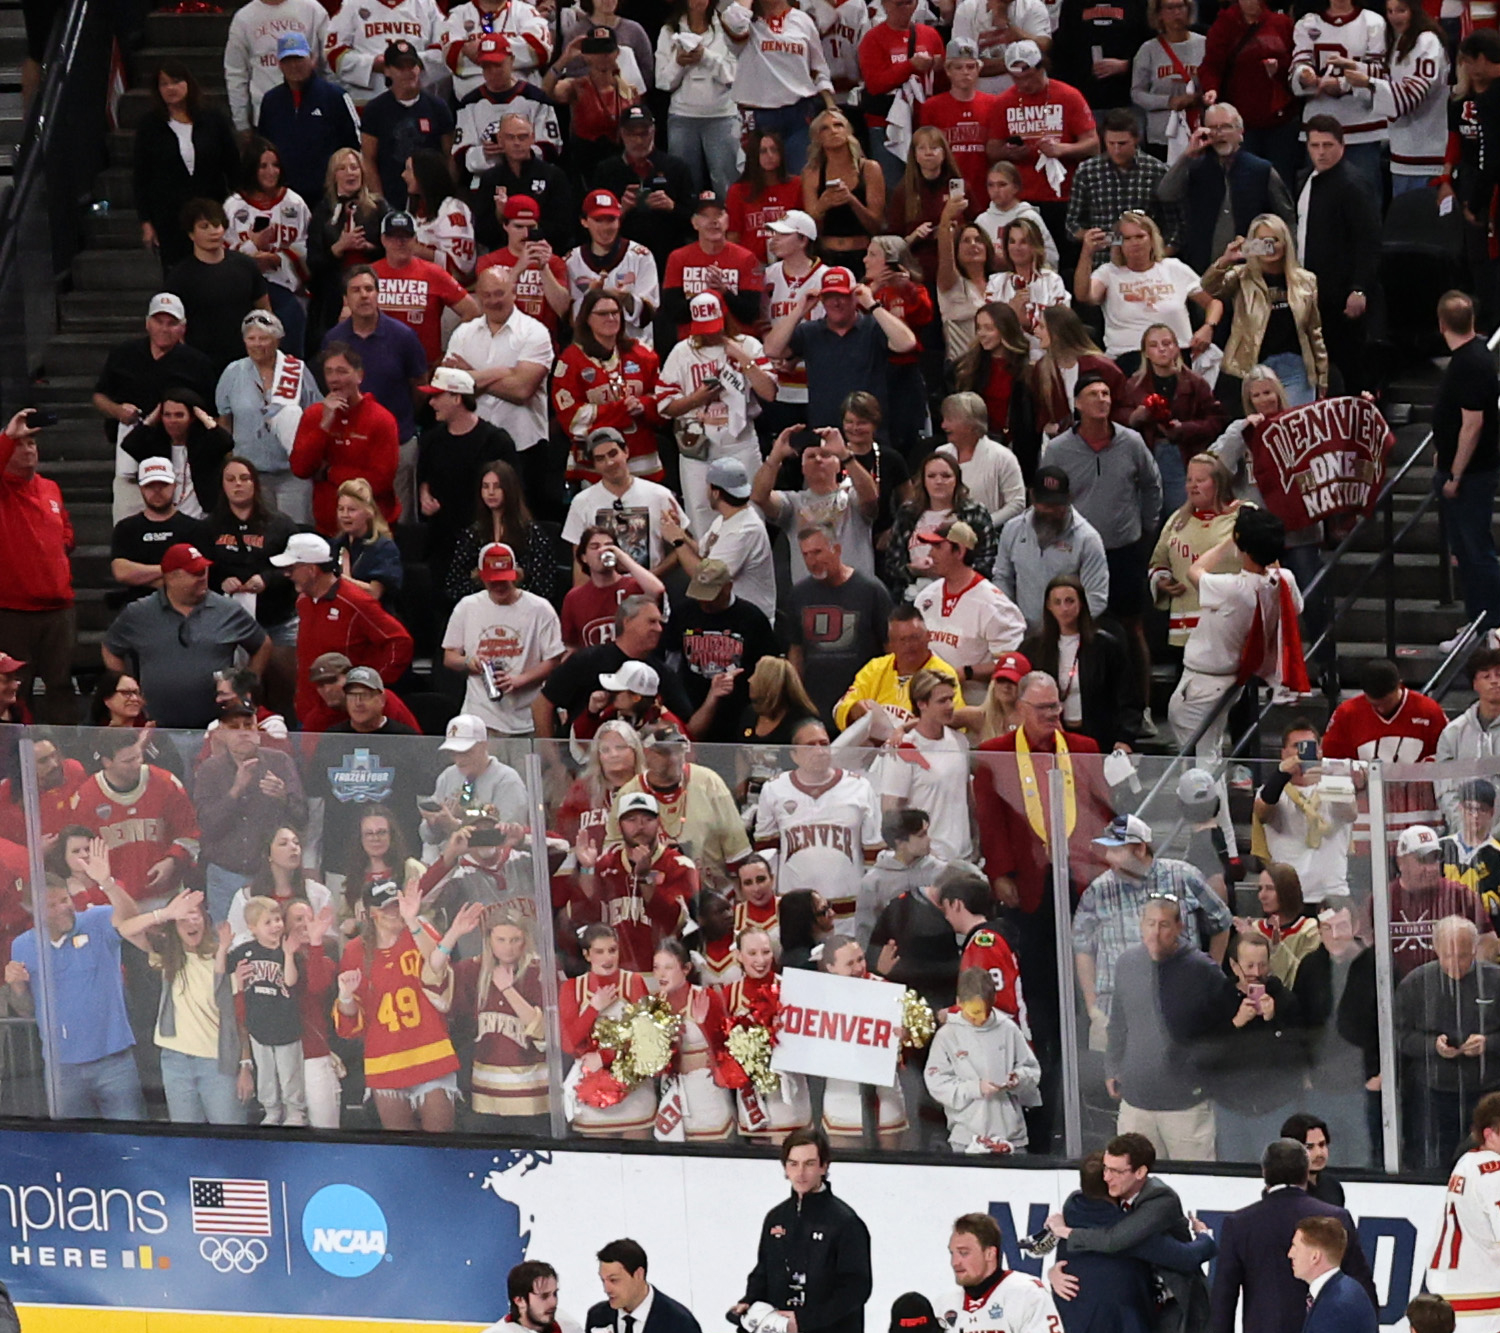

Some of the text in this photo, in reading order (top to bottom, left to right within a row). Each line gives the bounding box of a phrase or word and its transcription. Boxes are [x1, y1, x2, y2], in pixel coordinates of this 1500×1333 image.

[364, 22, 423, 39] DENVER
[761, 39, 804, 56] DENVER
[1415, 58, 1435, 78] 10
[1006, 104, 1064, 122] DENVER
[1263, 398, 1391, 487] DENVER
[1311, 451, 1355, 481] ONE
[1300, 476, 1371, 511] NATION
[801, 605, 858, 648] DU
[363, 770, 389, 783] FOUR
[786, 823, 854, 865] DENVER
[376, 986, 422, 1032] 49
[784, 1005, 892, 1049] DENVER
[313, 1227, 387, 1257] NCAA
[1430, 1200, 1462, 1270] 11
[11, 1246, 107, 1270] HERE
